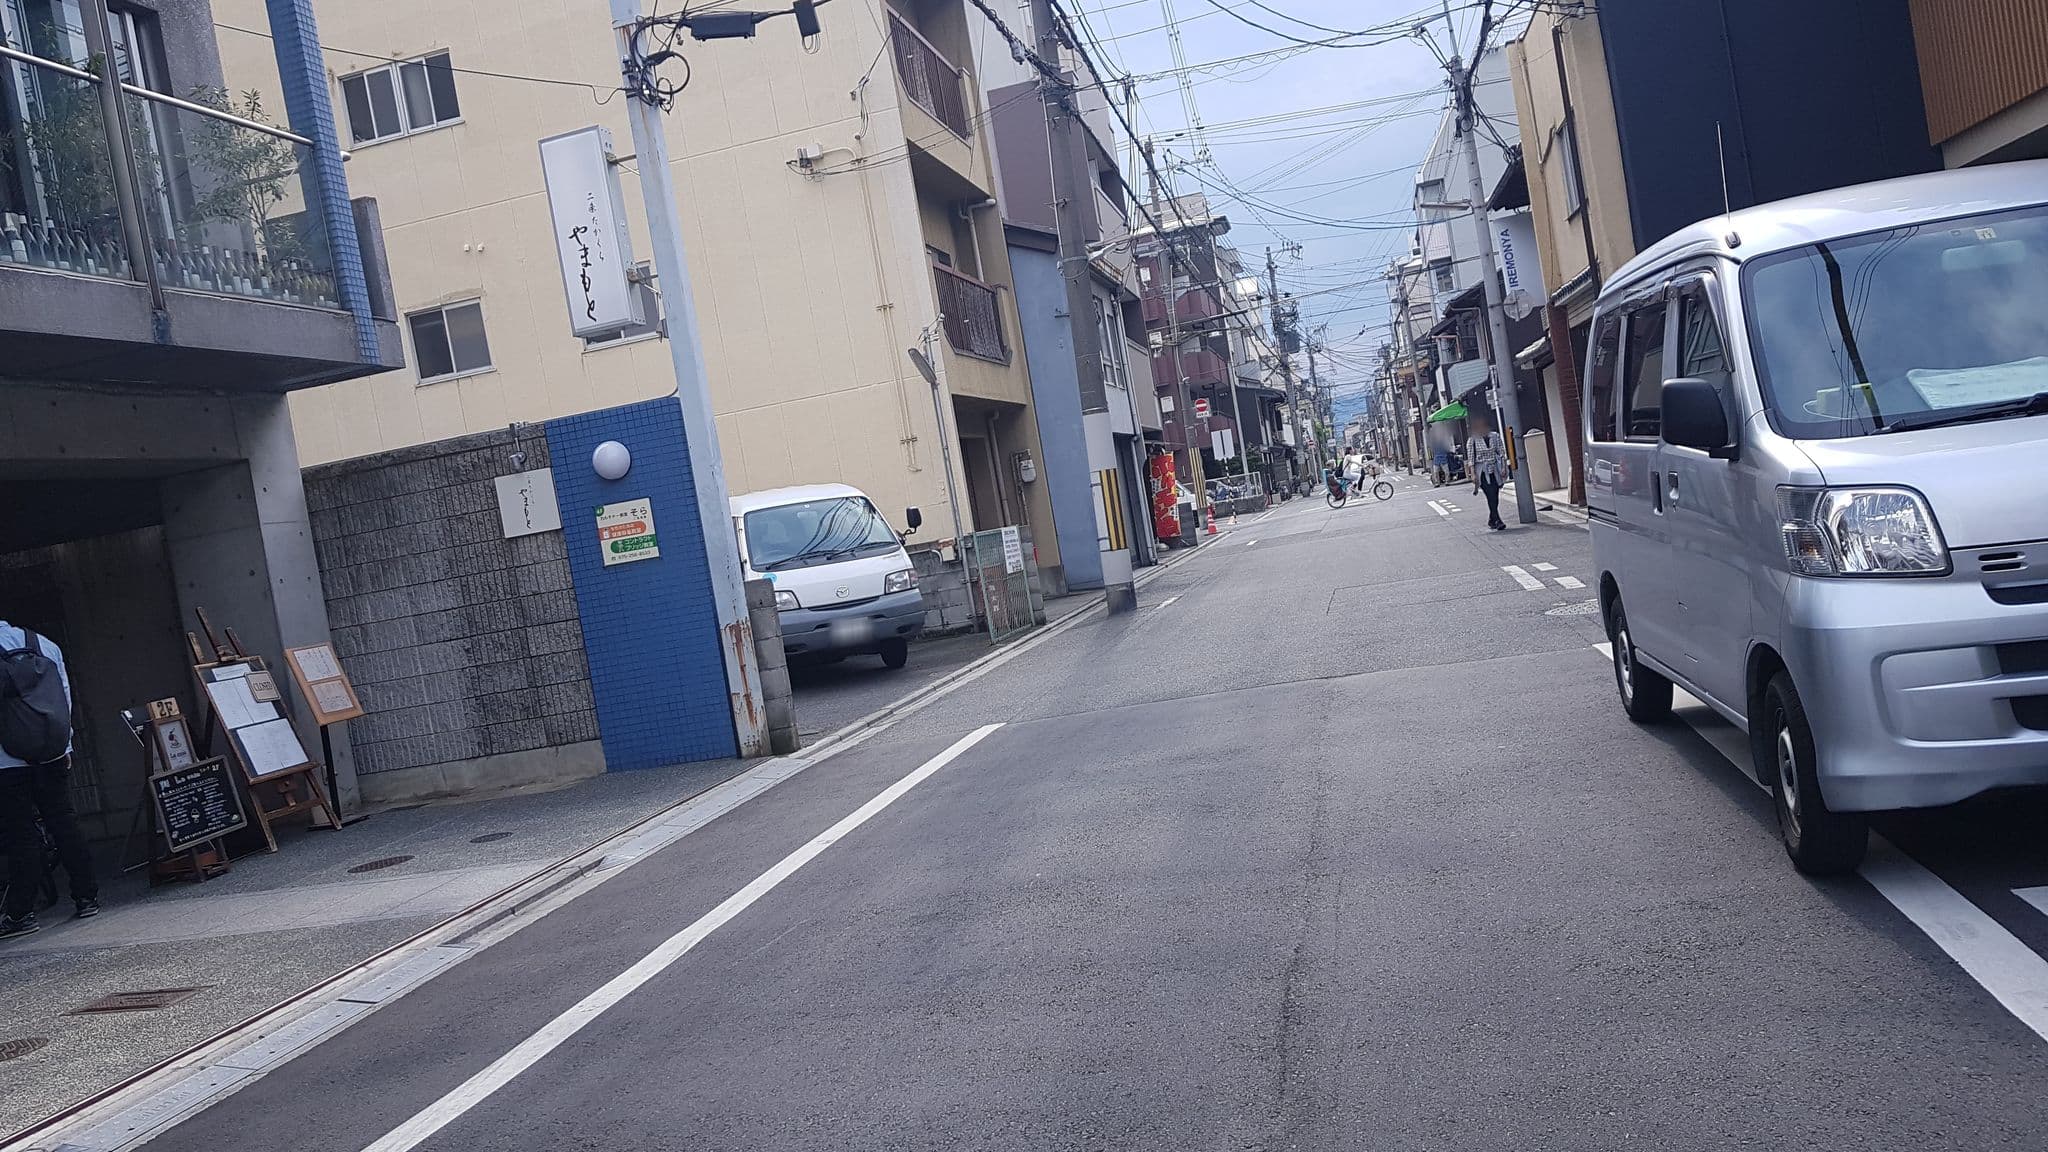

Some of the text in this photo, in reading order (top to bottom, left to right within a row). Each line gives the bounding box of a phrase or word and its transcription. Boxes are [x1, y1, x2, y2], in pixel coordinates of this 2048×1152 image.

[568, 225, 598, 322] やまもと
[1500, 228, 1520, 288] IREMONYA
[630, 506, 648, 517] そら
[156, 701, 173, 717] 2F
